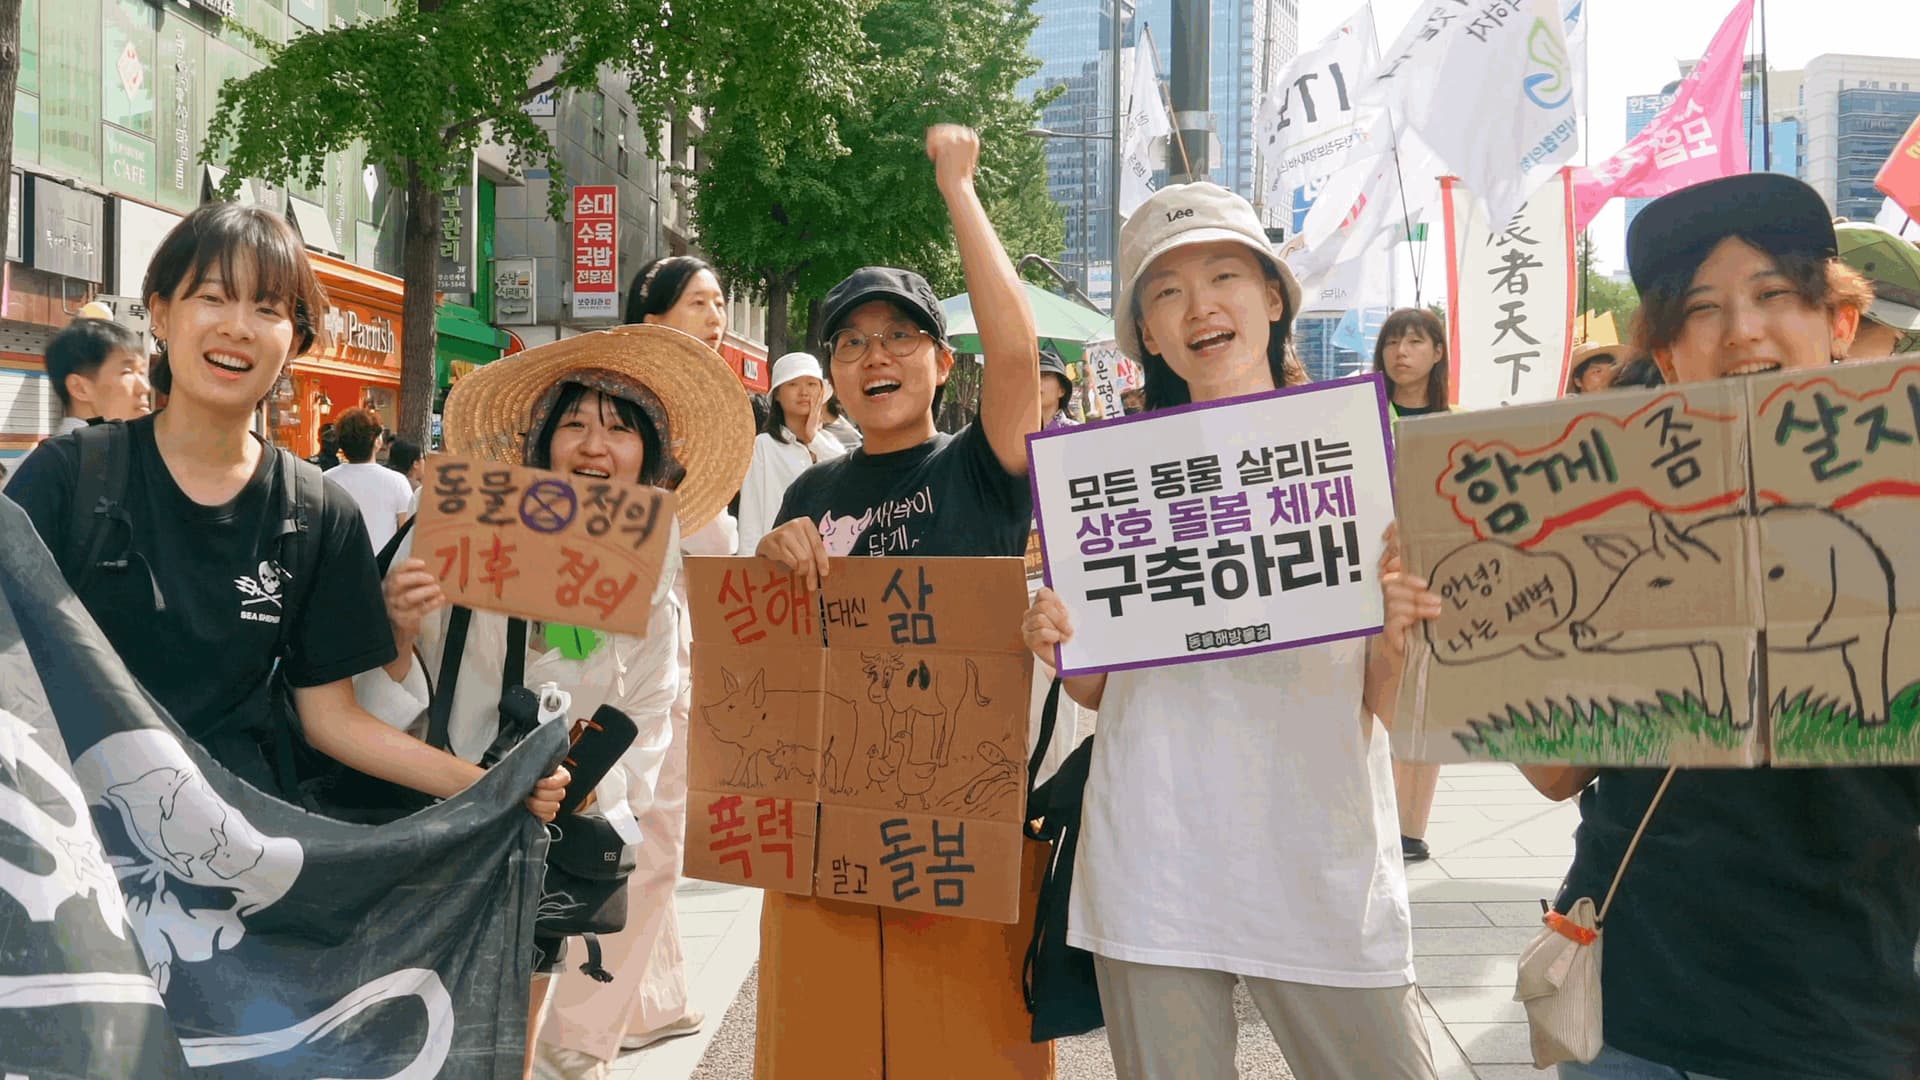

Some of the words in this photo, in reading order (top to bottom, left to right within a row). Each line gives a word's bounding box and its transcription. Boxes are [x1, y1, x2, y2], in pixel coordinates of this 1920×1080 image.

[113, 159, 146, 186] CAFE
[577, 194, 613, 214] 순대
[577, 222, 613, 244] 수육
[1166, 208, 1194, 223] Lee
[576, 246, 613, 267] 국밥
[576, 269, 613, 285] 전문점
[497, 287, 529, 298] 시래기
[348, 310, 395, 354] Parrish
[1068, 468, 1139, 513] 모든
[1150, 454, 1223, 500] 동물
[1236, 438, 1354, 487] 살리는
[1453, 428, 1619, 534] 함께
[1644, 405, 1703, 489] 좀
[434, 463, 519, 526] 동물
[582, 482, 663, 550] 정의
[1076, 507, 1157, 556] 상호
[1168, 491, 1252, 543] 돌봄
[1266, 475, 1357, 527] 체제
[434, 532, 520, 599] 기후
[555, 545, 639, 621] 정의
[1083, 521, 1363, 618] 구축하라!
[1441, 557, 1502, 612] 안녕?
[718, 566, 812, 646] 살해
[827, 596, 868, 629] 대신
[881, 565, 938, 646] 삶
[1447, 618, 1499, 655] 나는
[1504, 573, 1561, 624] 새벽
[604, 851, 617, 862] EOS
[708, 795, 795, 880] 폭력
[832, 854, 868, 896] 말고
[879, 818, 975, 908] 돌봄
